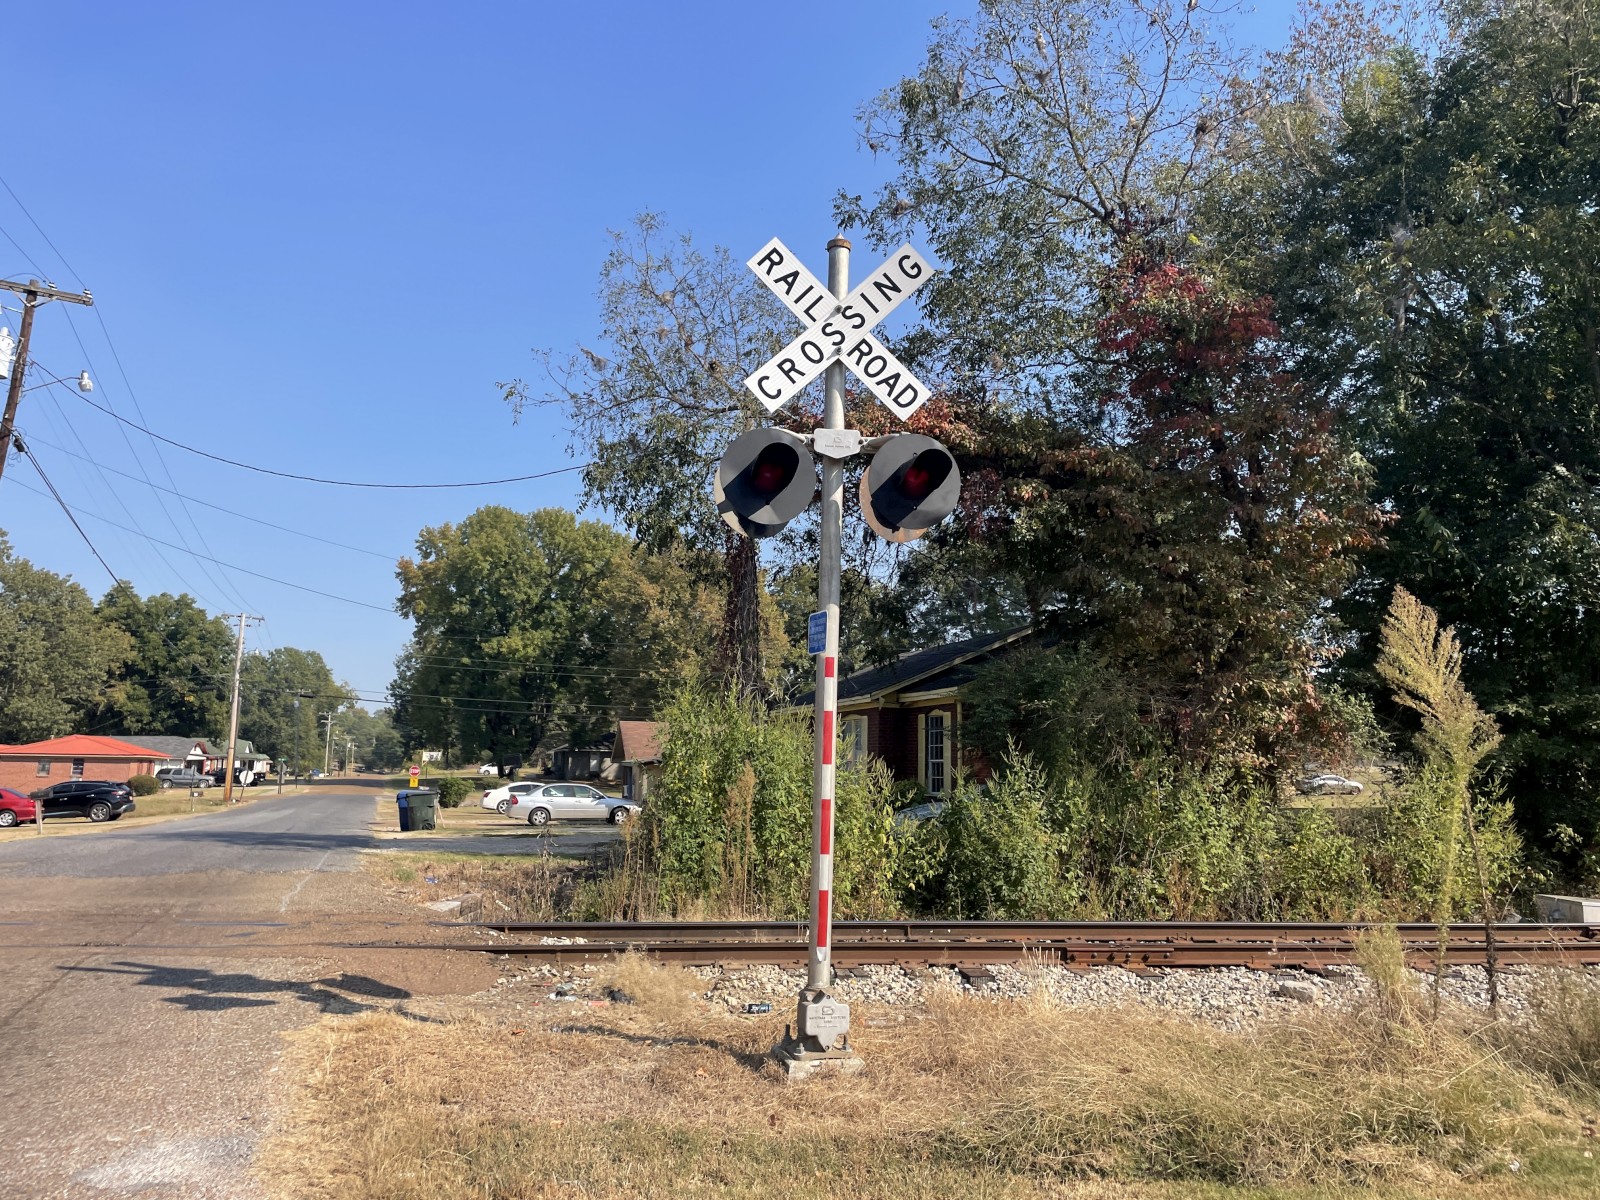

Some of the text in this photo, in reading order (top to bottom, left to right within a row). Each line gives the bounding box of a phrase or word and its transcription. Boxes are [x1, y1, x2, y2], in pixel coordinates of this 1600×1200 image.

[757, 254, 922, 400] CROSSING
[757, 247, 919, 409] RAIL ROAD
